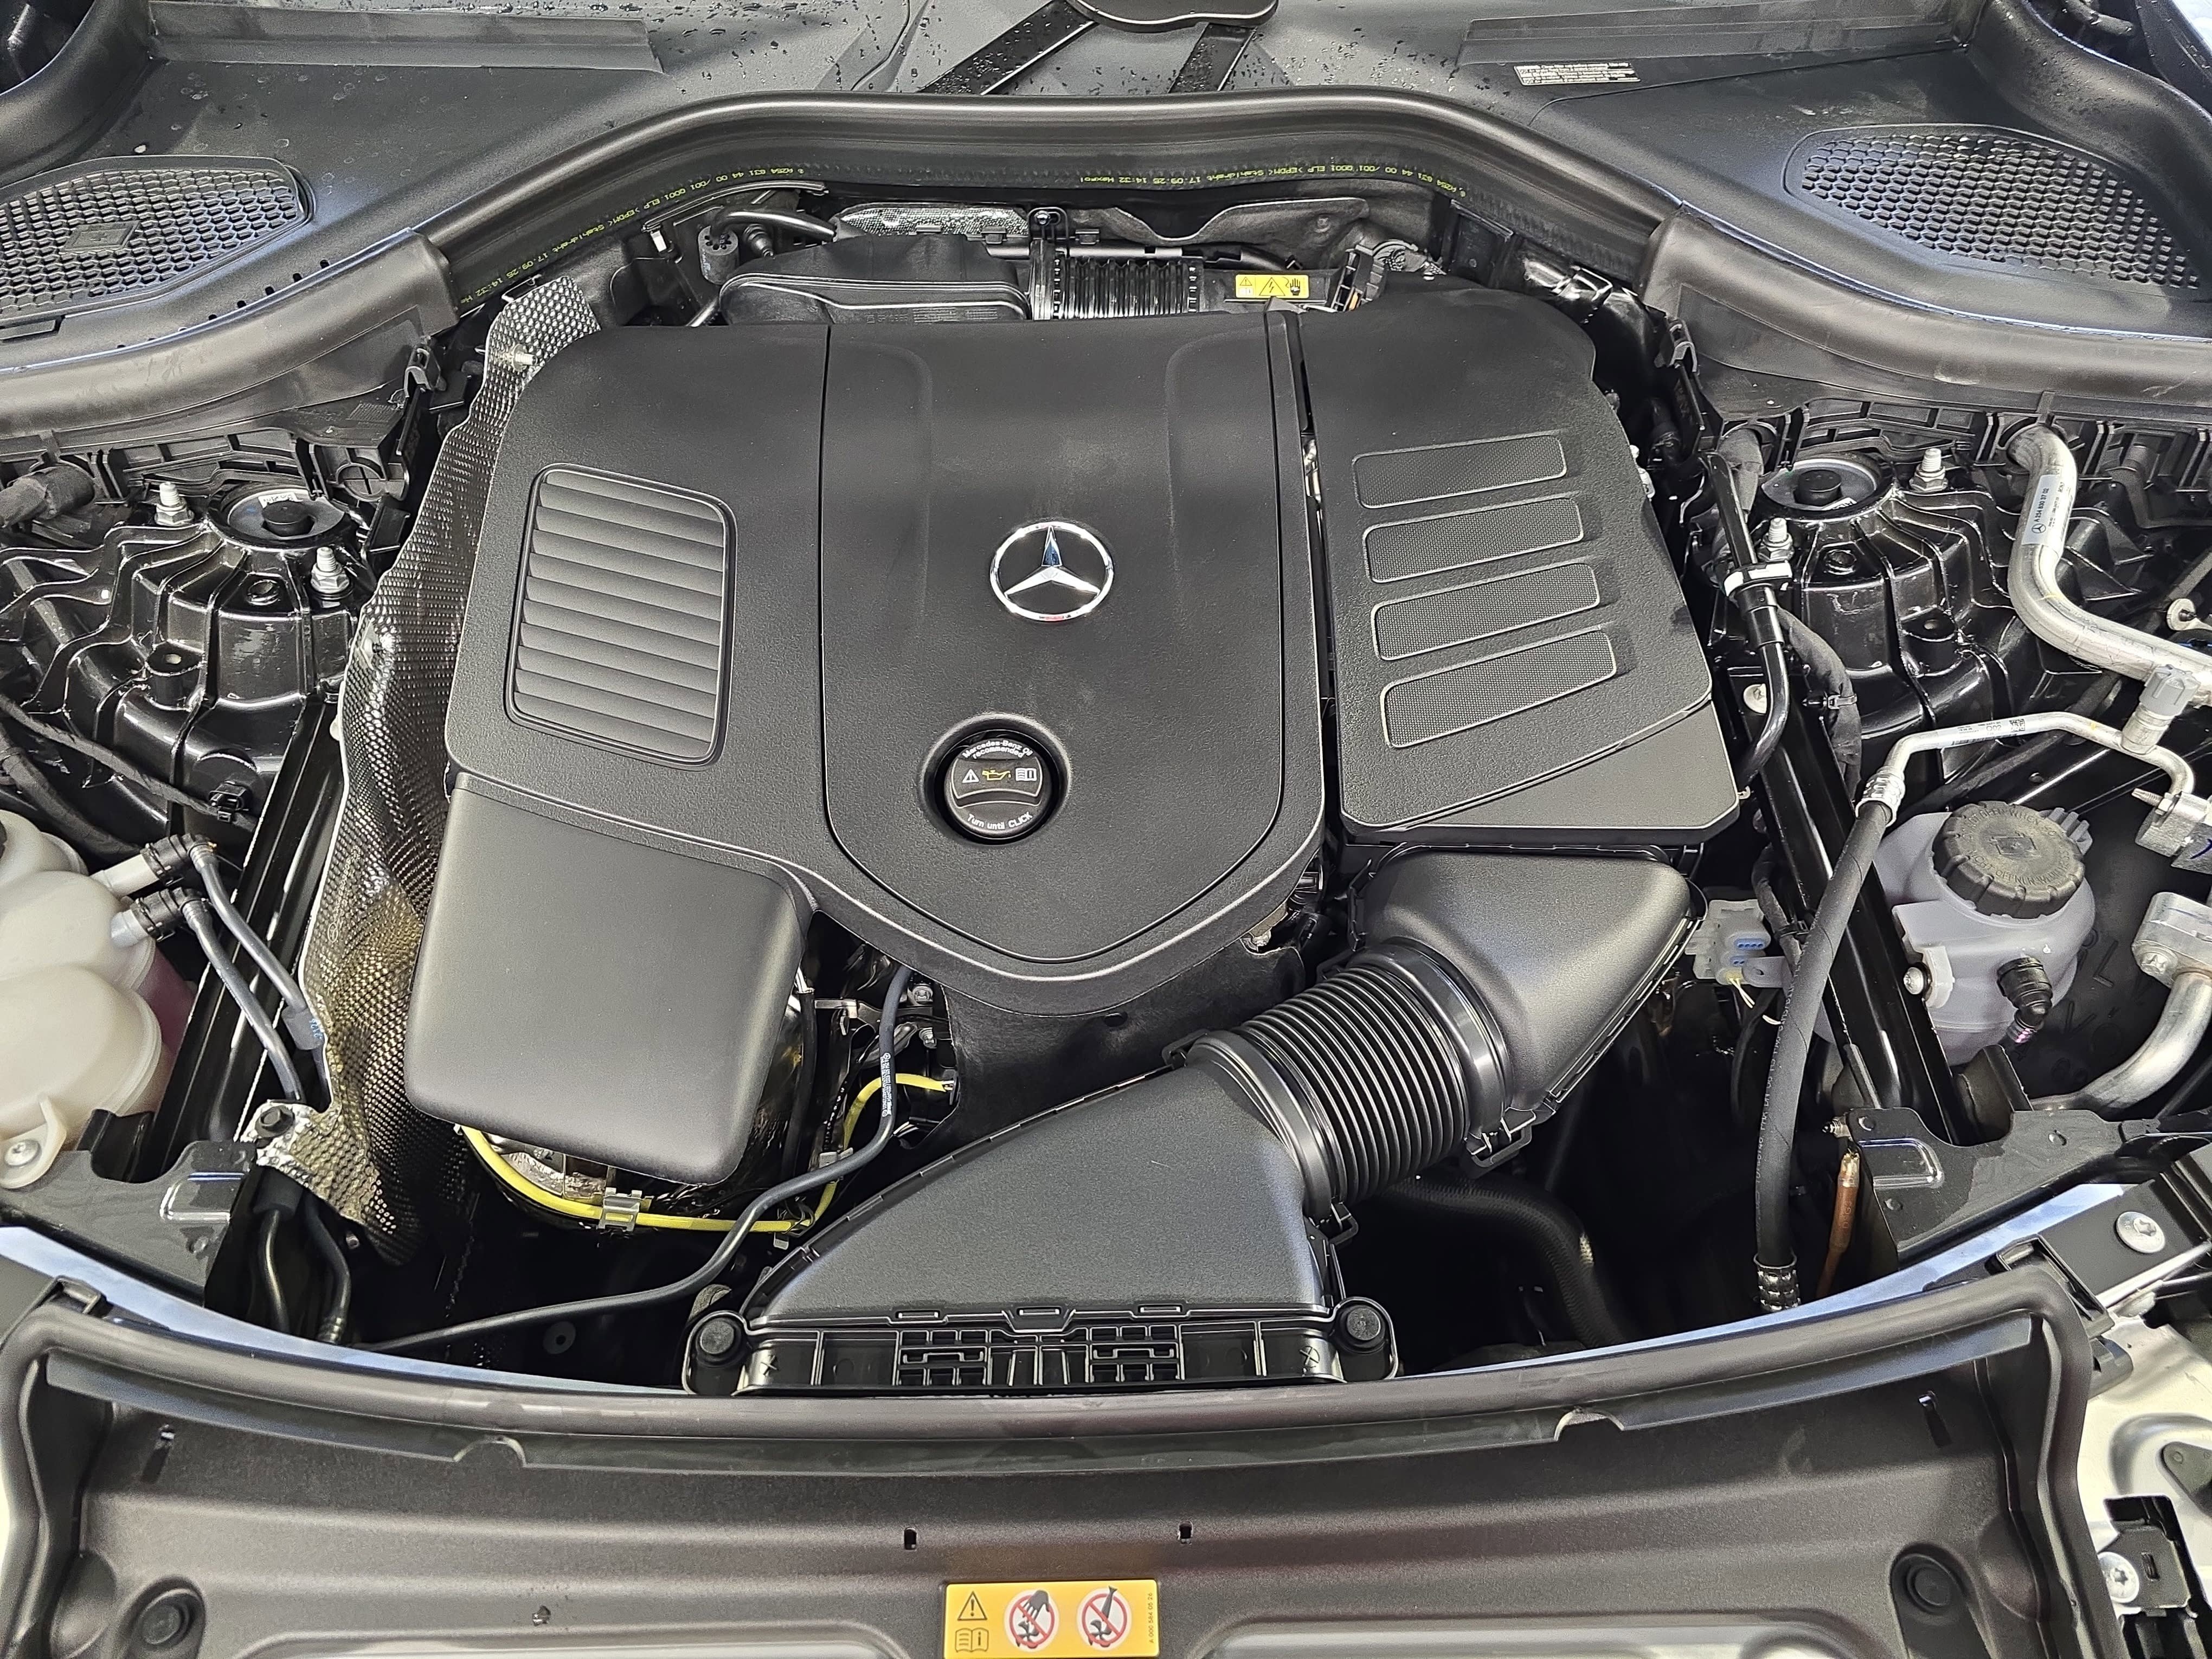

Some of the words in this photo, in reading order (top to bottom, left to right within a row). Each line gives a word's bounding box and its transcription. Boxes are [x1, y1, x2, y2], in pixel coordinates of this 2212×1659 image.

[716, 174, 729, 182] 00
[552, 224, 605, 253] Stahldraht
[506, 253, 548, 279] 17.09.25
[475, 278, 503, 297] 14:32
[962, 740, 1023, 758] Mercedes-Benz
[1023, 747, 1034, 756] Oil
[972, 745, 1025, 760] recommended
[967, 813, 985, 828] Turn
[987, 822, 1005, 830] until
[1007, 811, 1033, 828] CLICK
